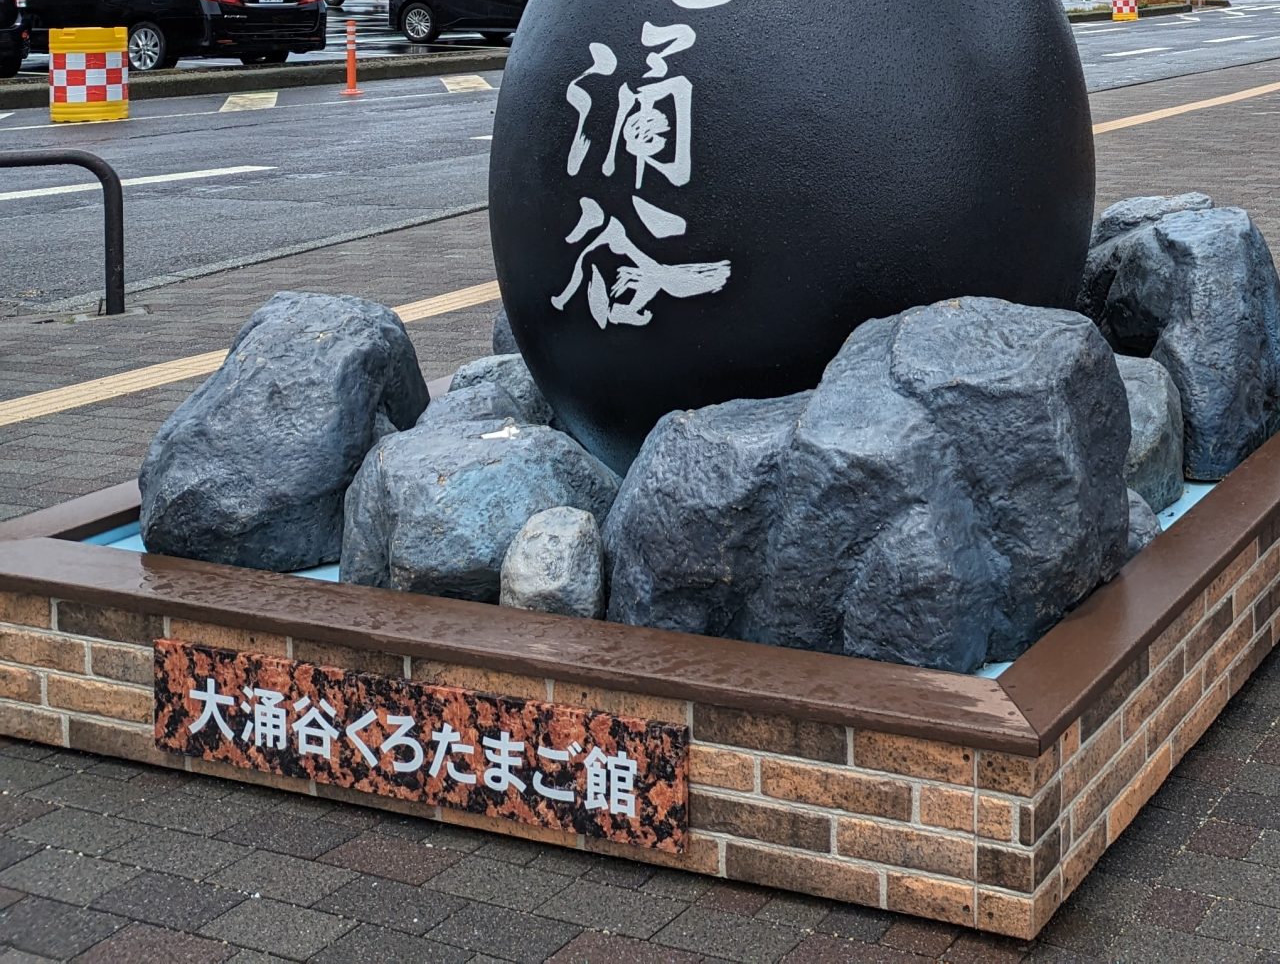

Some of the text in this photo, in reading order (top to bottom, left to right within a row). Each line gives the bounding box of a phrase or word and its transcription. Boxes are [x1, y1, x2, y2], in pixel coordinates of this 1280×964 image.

[188, 677, 638, 818] 大涌谷くろたまご館
